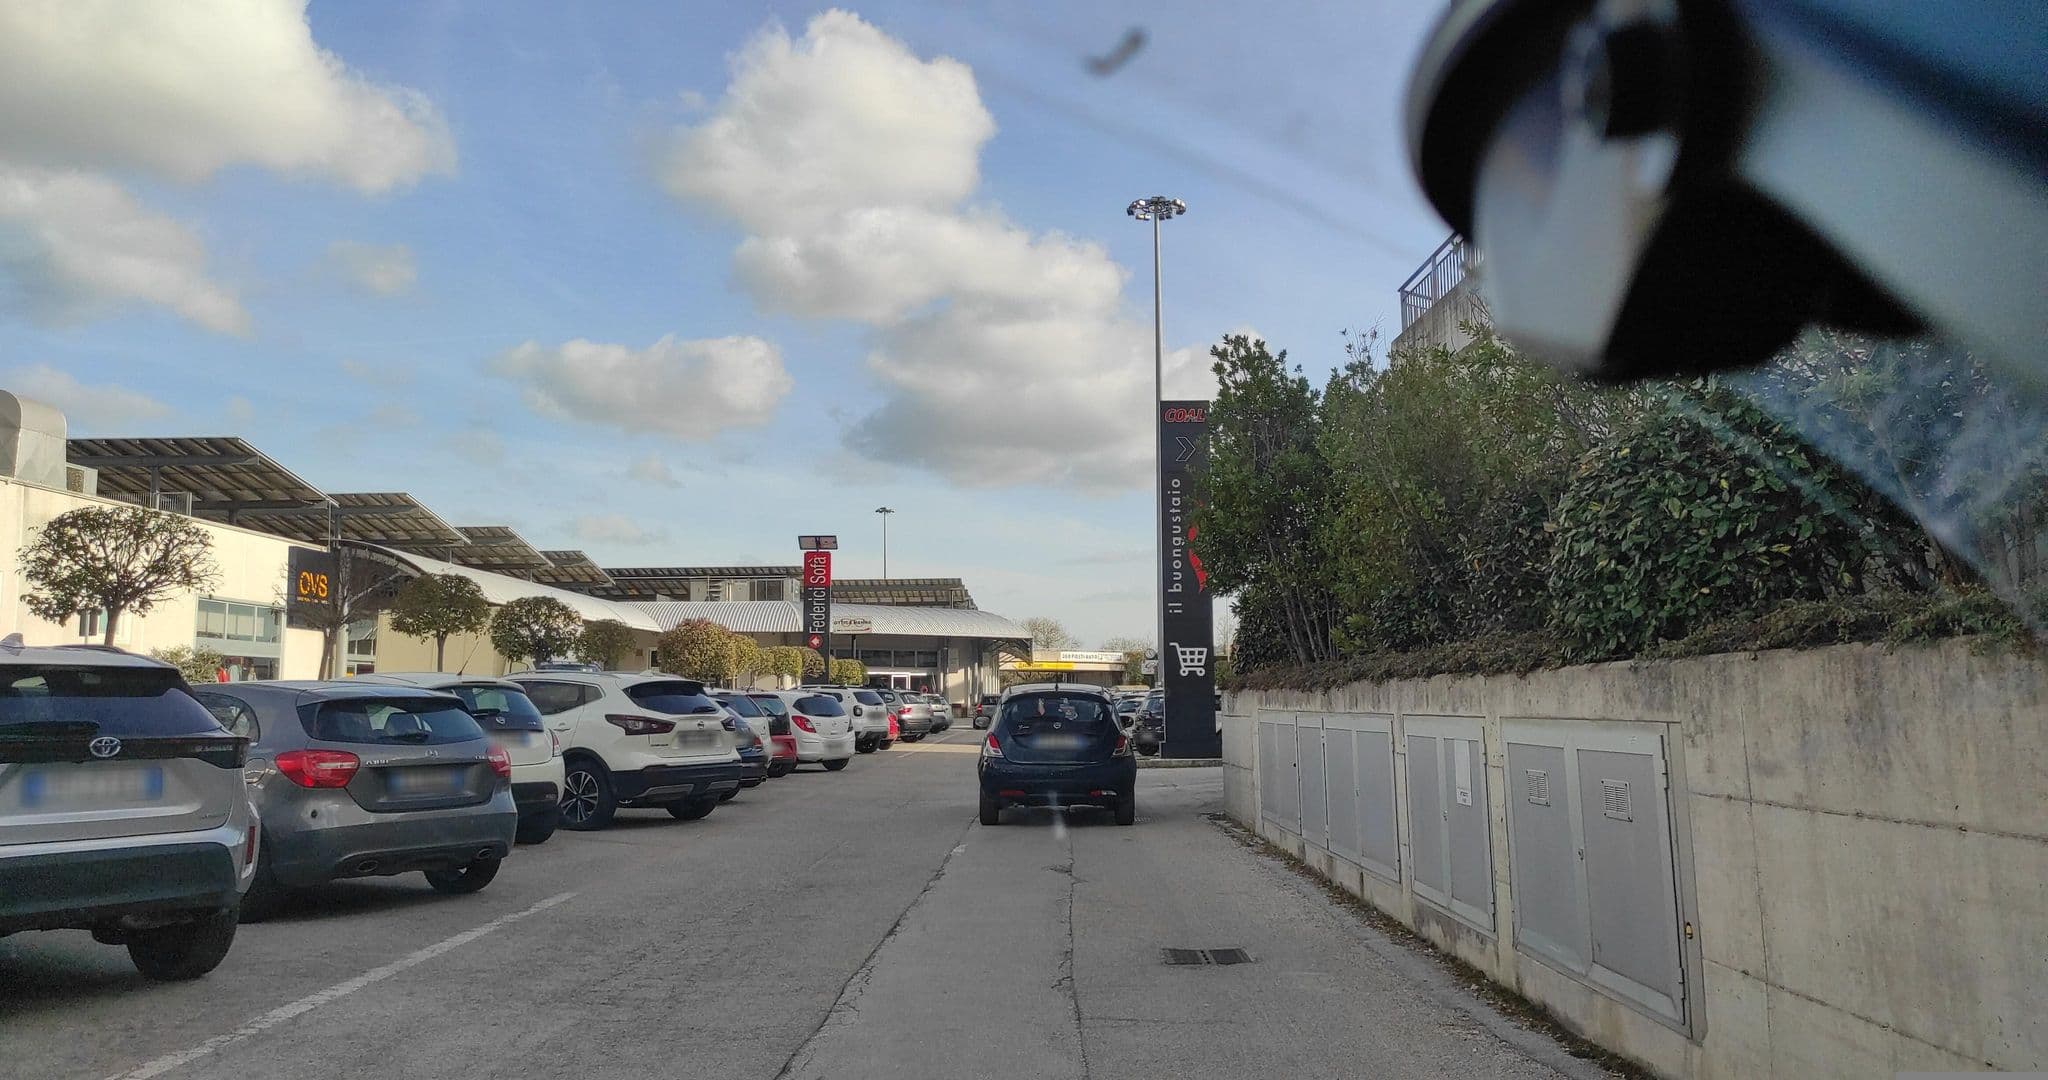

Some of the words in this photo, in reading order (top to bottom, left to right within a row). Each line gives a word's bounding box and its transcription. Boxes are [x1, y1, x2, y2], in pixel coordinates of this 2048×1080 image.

[1164, 407, 1206, 423] COAL
[1168, 478, 1185, 593] buongustaio
[808, 556, 827, 584] Sofà
[299, 571, 328, 598] OVS
[808, 587, 826, 634] Federici
[1168, 603, 1182, 614] il
